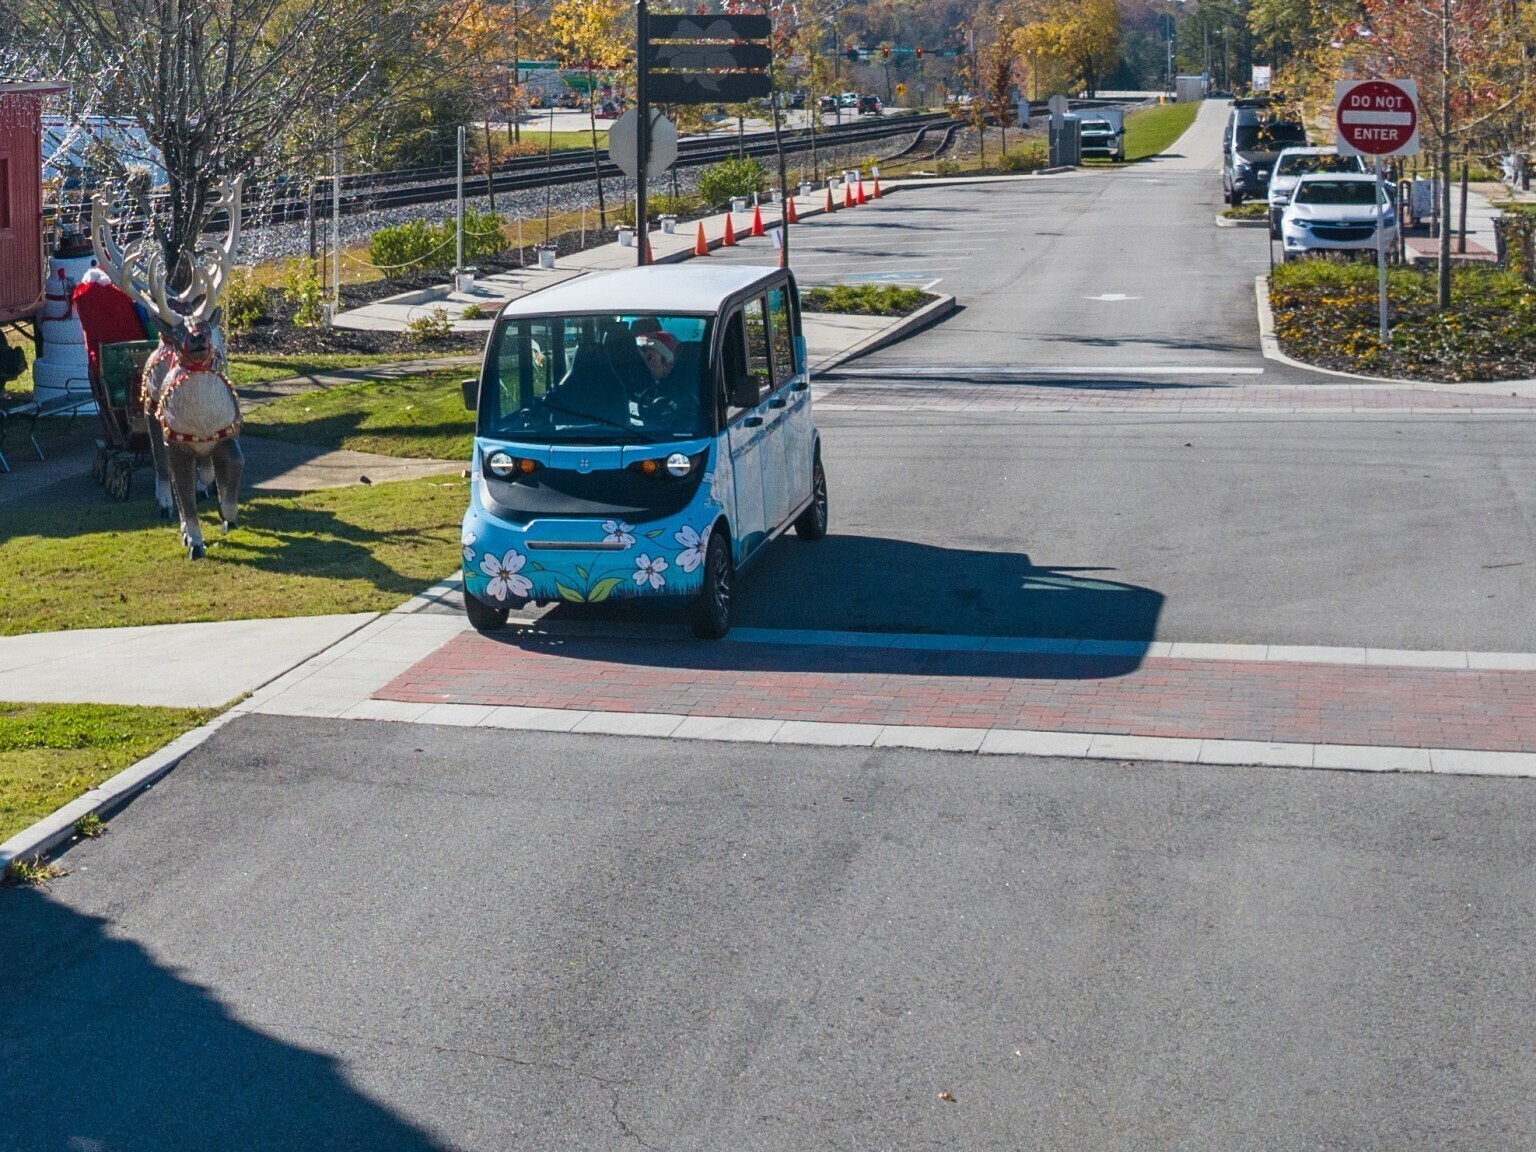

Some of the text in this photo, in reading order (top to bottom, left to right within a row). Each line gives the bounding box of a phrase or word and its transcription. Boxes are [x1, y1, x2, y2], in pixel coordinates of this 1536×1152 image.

[1351, 95, 1403, 108] DO NOT
[1354, 128, 1398, 140] ENTER
